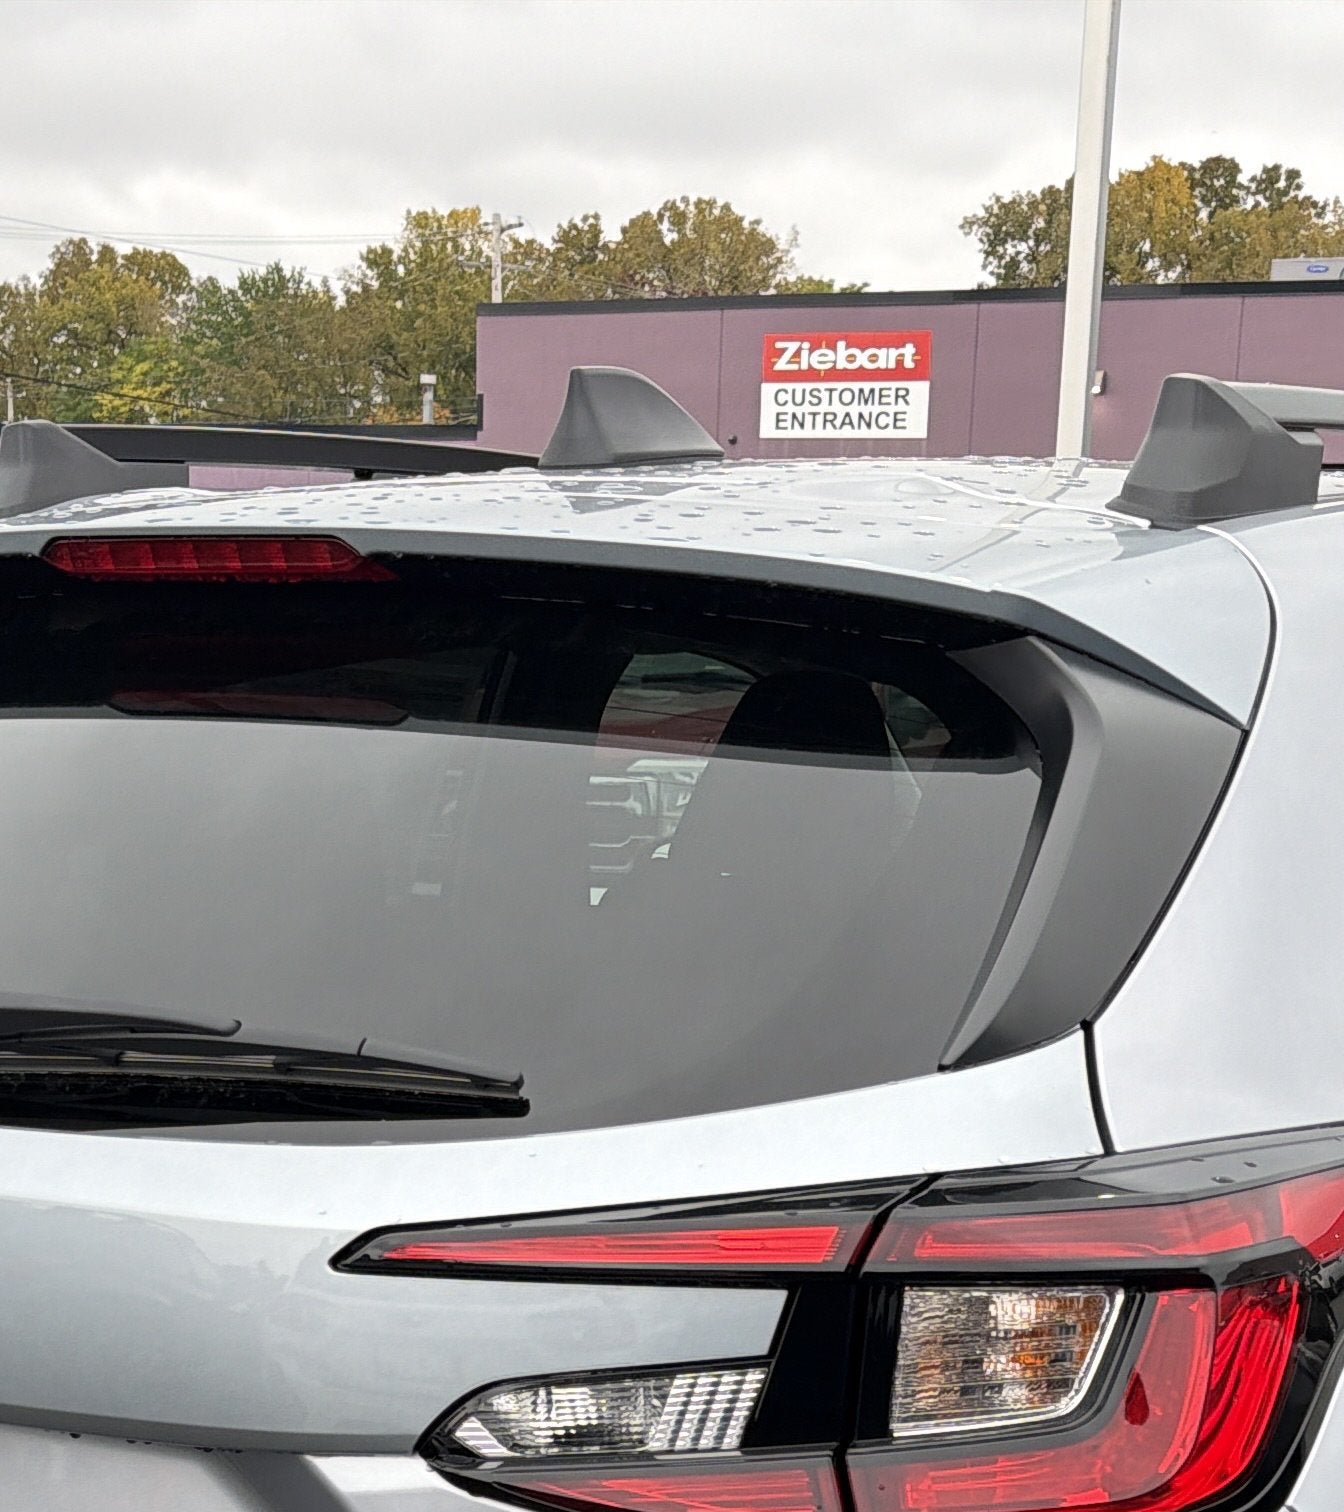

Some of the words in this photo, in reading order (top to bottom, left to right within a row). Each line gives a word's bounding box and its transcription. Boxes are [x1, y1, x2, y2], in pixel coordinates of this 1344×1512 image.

[772, 341, 916, 371] Ziebart
[774, 387, 910, 407] CUSTOMER
[774, 411, 908, 430] ENTRANCE
